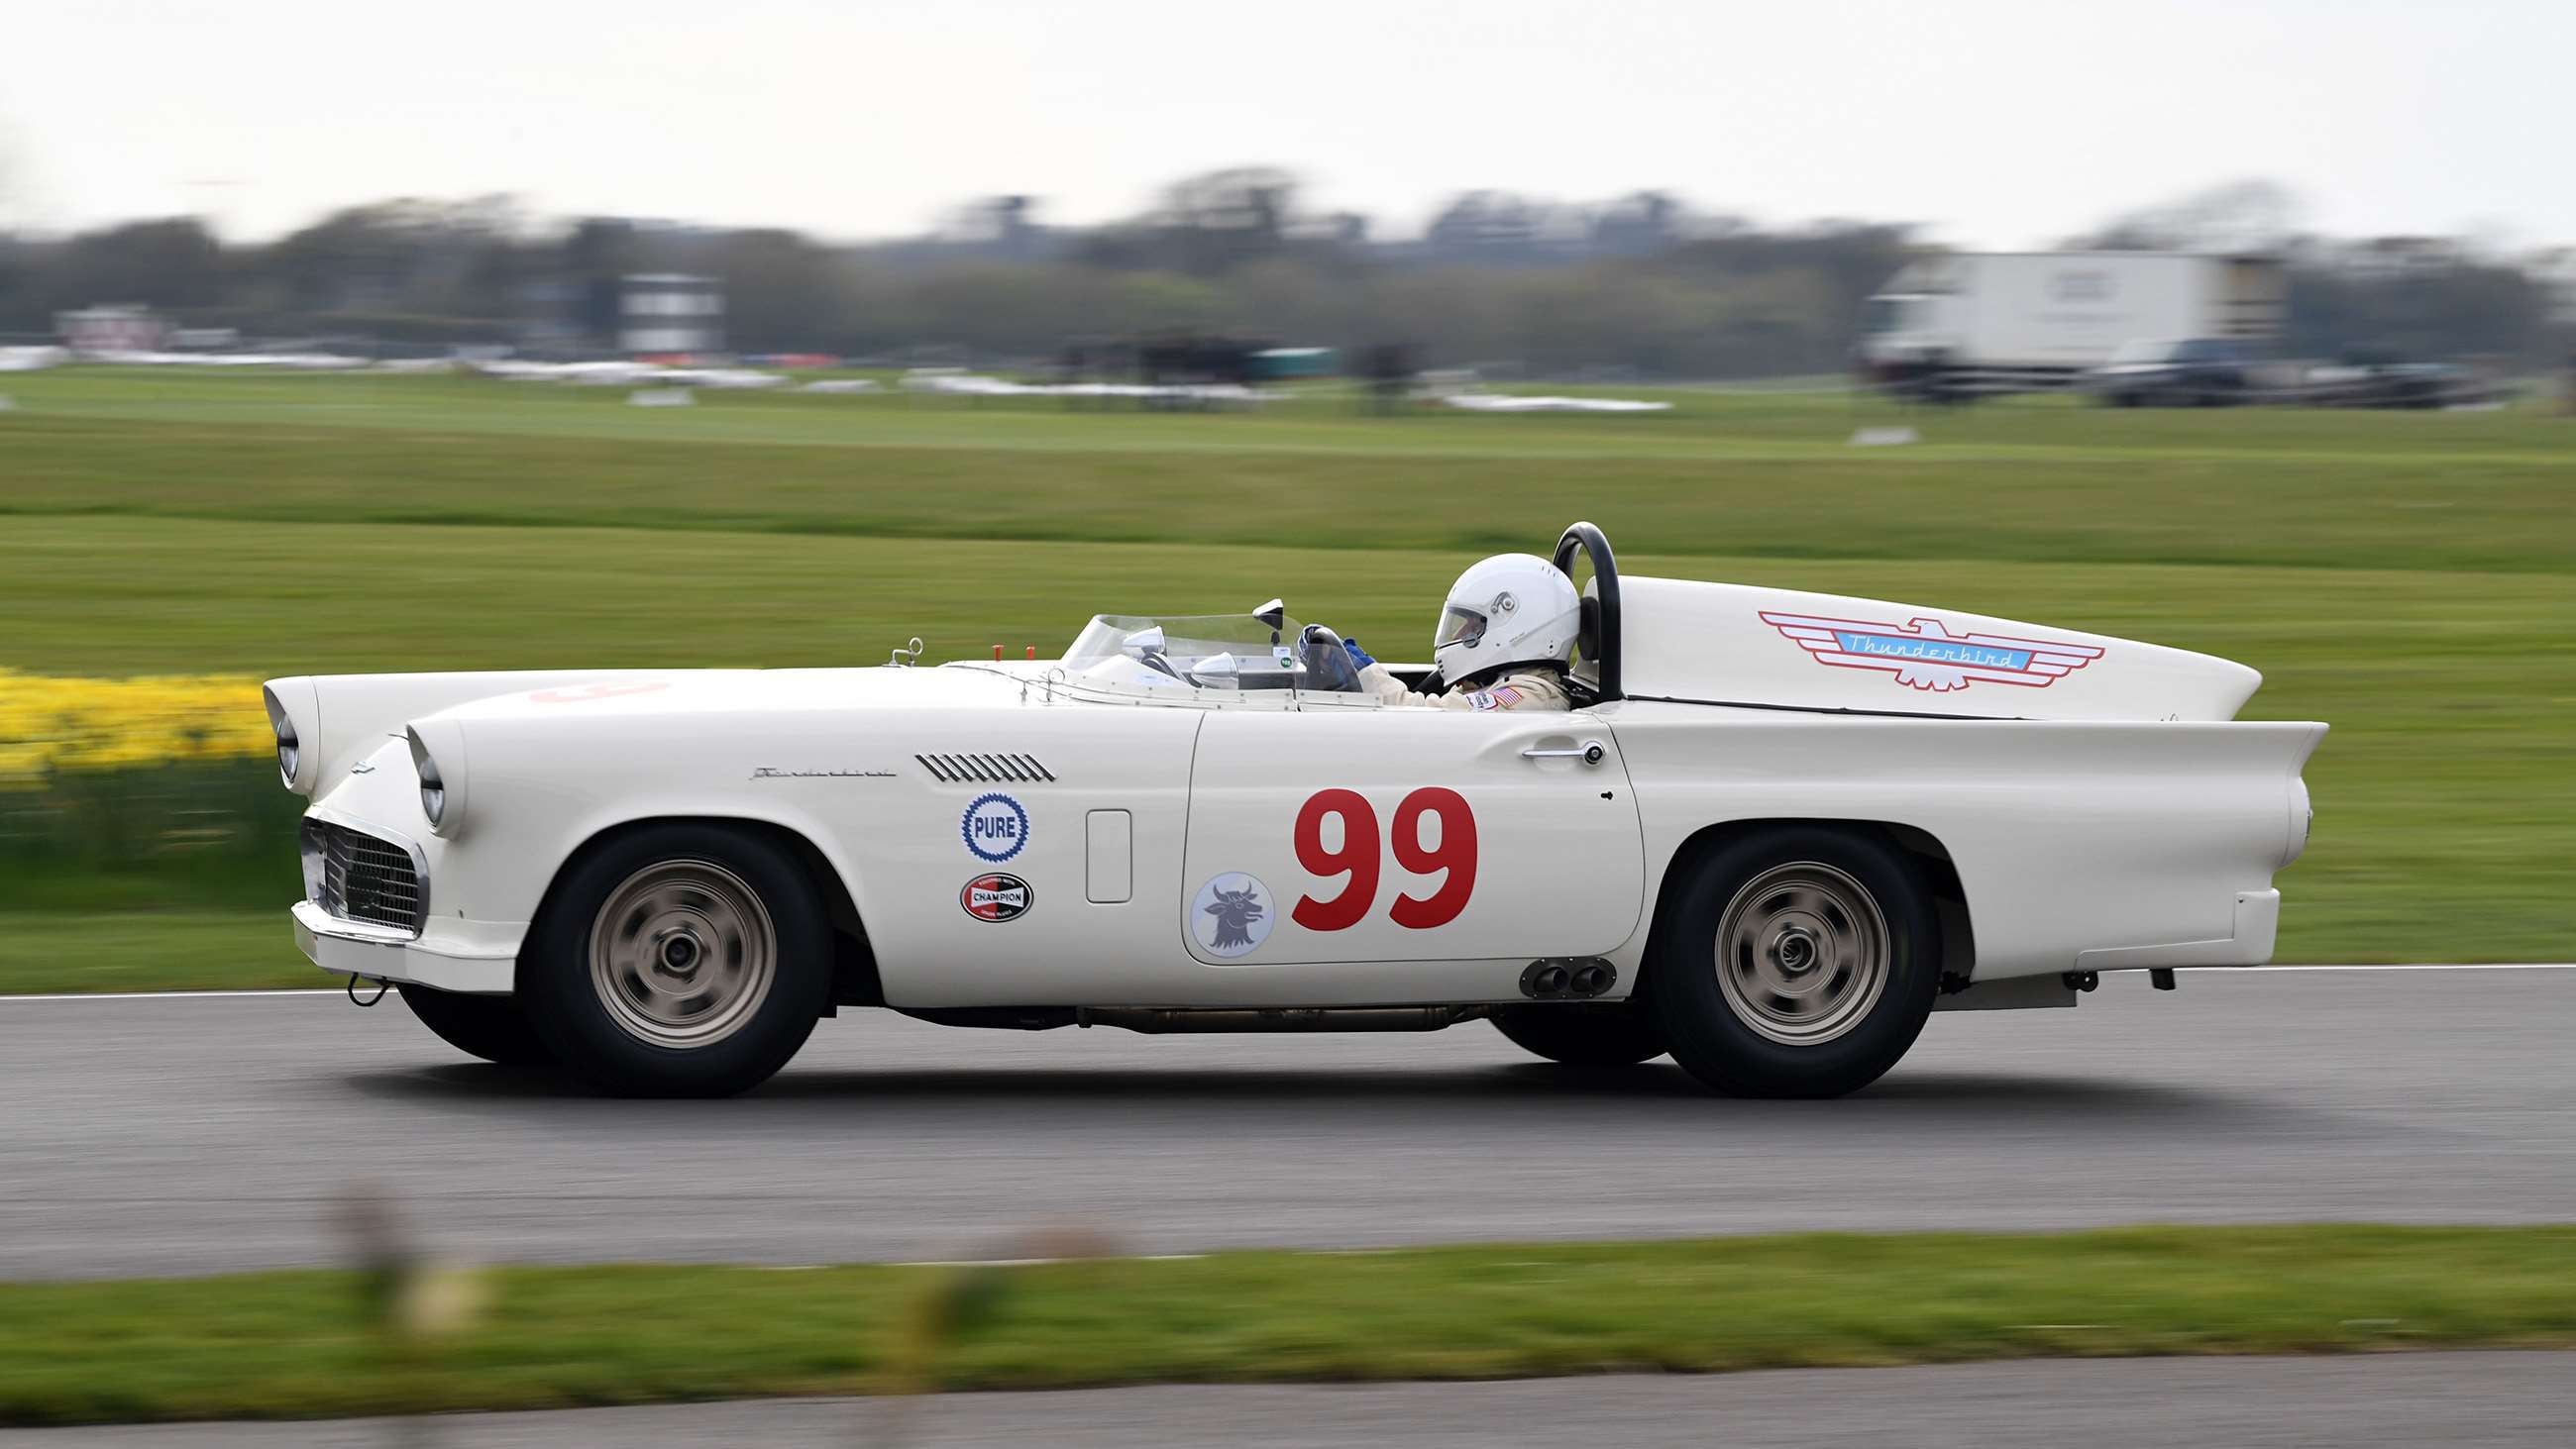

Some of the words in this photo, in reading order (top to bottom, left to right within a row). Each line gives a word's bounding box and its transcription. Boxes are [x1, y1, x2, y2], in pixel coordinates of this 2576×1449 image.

[1850, 634, 2018, 669] Thunderbird
[975, 816, 1016, 838] PURE
[1292, 787, 1478, 932] 99
[973, 892, 1021, 902] CHAMPION
